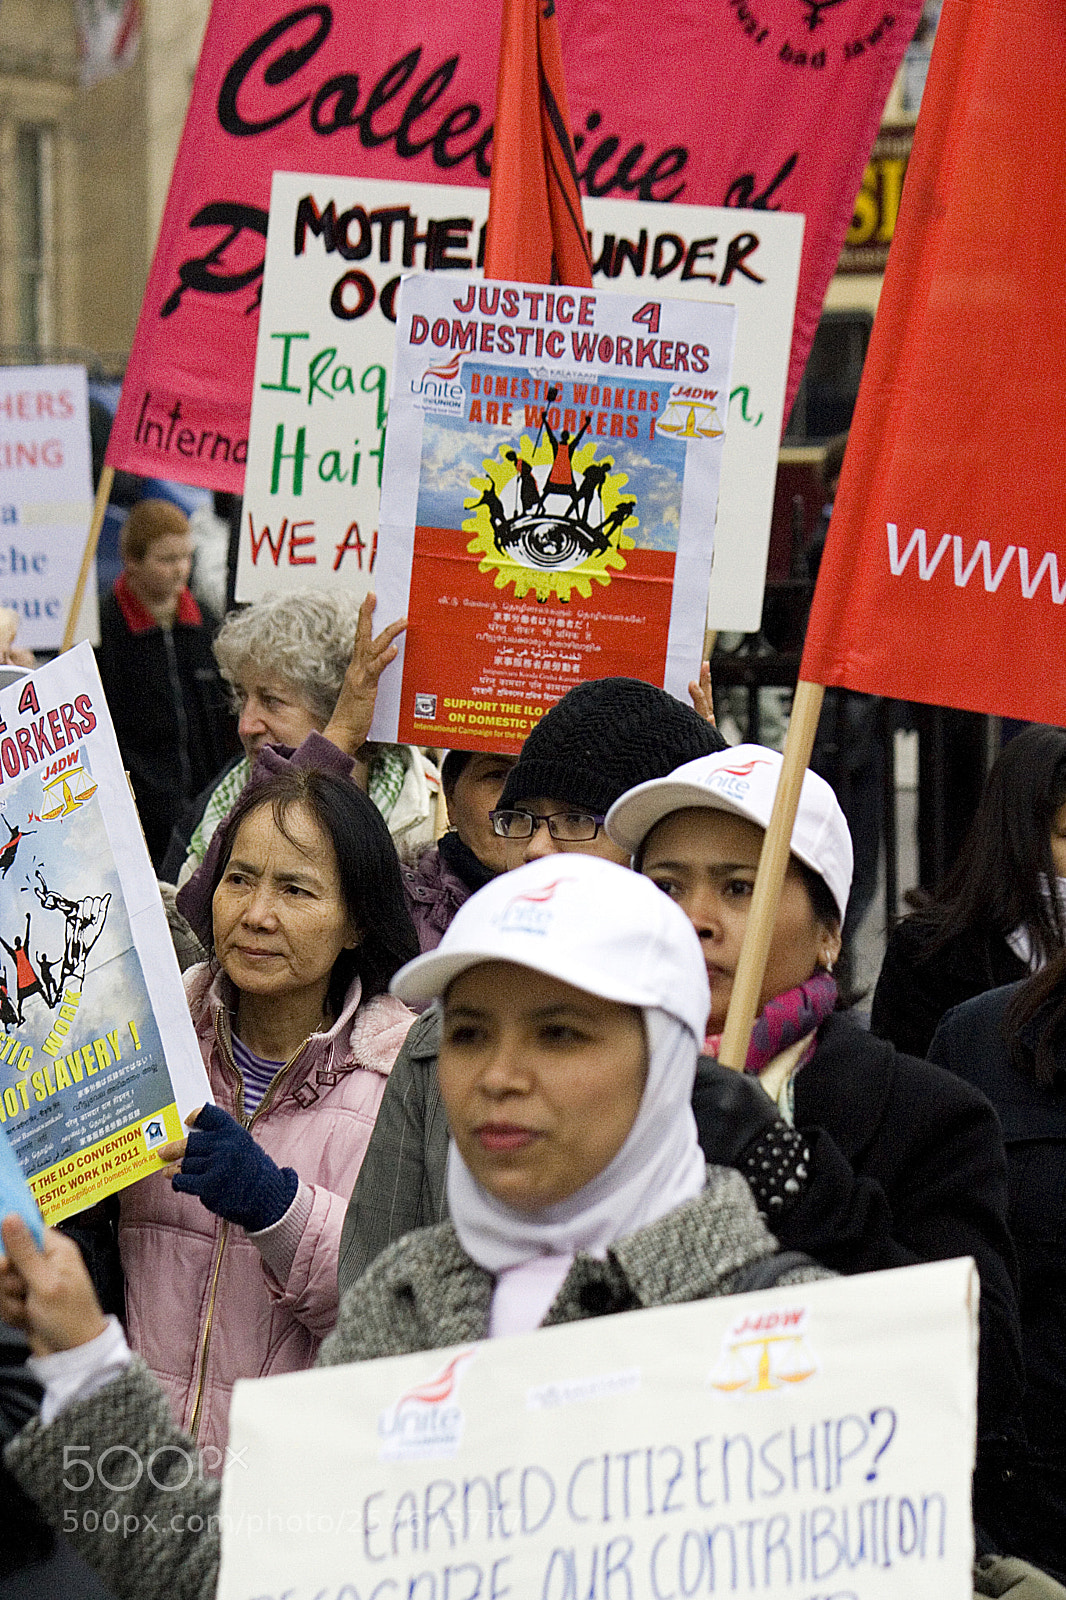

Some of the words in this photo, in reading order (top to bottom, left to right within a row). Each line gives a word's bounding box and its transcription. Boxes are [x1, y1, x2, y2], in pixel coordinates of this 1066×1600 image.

[453, 284, 597, 327] JUSTICE
[631, 301, 662, 334] 4
[409, 314, 567, 359] DOMESTIC
[571, 330, 710, 374] WORKERS
[410, 379, 463, 401] unite
[470, 372, 564, 403] DOMESTIC
[573, 383, 660, 413] WORKERS
[672, 385, 719, 401] J4DW
[469, 398, 514, 427] ARE
[524, 404, 640, 440] WORKERS
[0, 438, 64, 469] ING
[248, 511, 318, 567] WE
[18, 680, 41, 716] 4
[443, 697, 498, 713] SUPPORT
[500, 703, 522, 714] THE
[524, 706, 544, 717] ILO
[0, 693, 97, 785] ORKERS
[413, 721, 458, 734] International
[458, 726, 493, 738] Campaign
[448, 712, 466, 724] ON
[468, 714, 528, 730] DOMESTIC
[42, 749, 79, 781] J4DW
[41, 988, 82, 1058] WORK
[31, 1028, 122, 1103] SLAVERY
[128, 1019, 142, 1051] !
[38, 1170, 57, 1188] THE
[58, 1161, 75, 1178] ILO
[76, 1127, 142, 1168] CONVENTION
[68, 1166, 100, 1190] WORK
[101, 1160, 113, 1174] IN
[114, 1146, 140, 1167] 2011
[51, 1202, 61, 1213] the
[61, 1183, 96, 1206] Recognition
[97, 1179, 104, 1189] of
[104, 1165, 133, 1185] Domestic
[132, 1156, 148, 1170] Work
[148, 1153, 157, 1161] as
[363, 1464, 556, 1563] EARNED
[567, 1405, 898, 1524] CITIZENSHIP?
[650, 1491, 947, 1600] CONTRIBUTION
